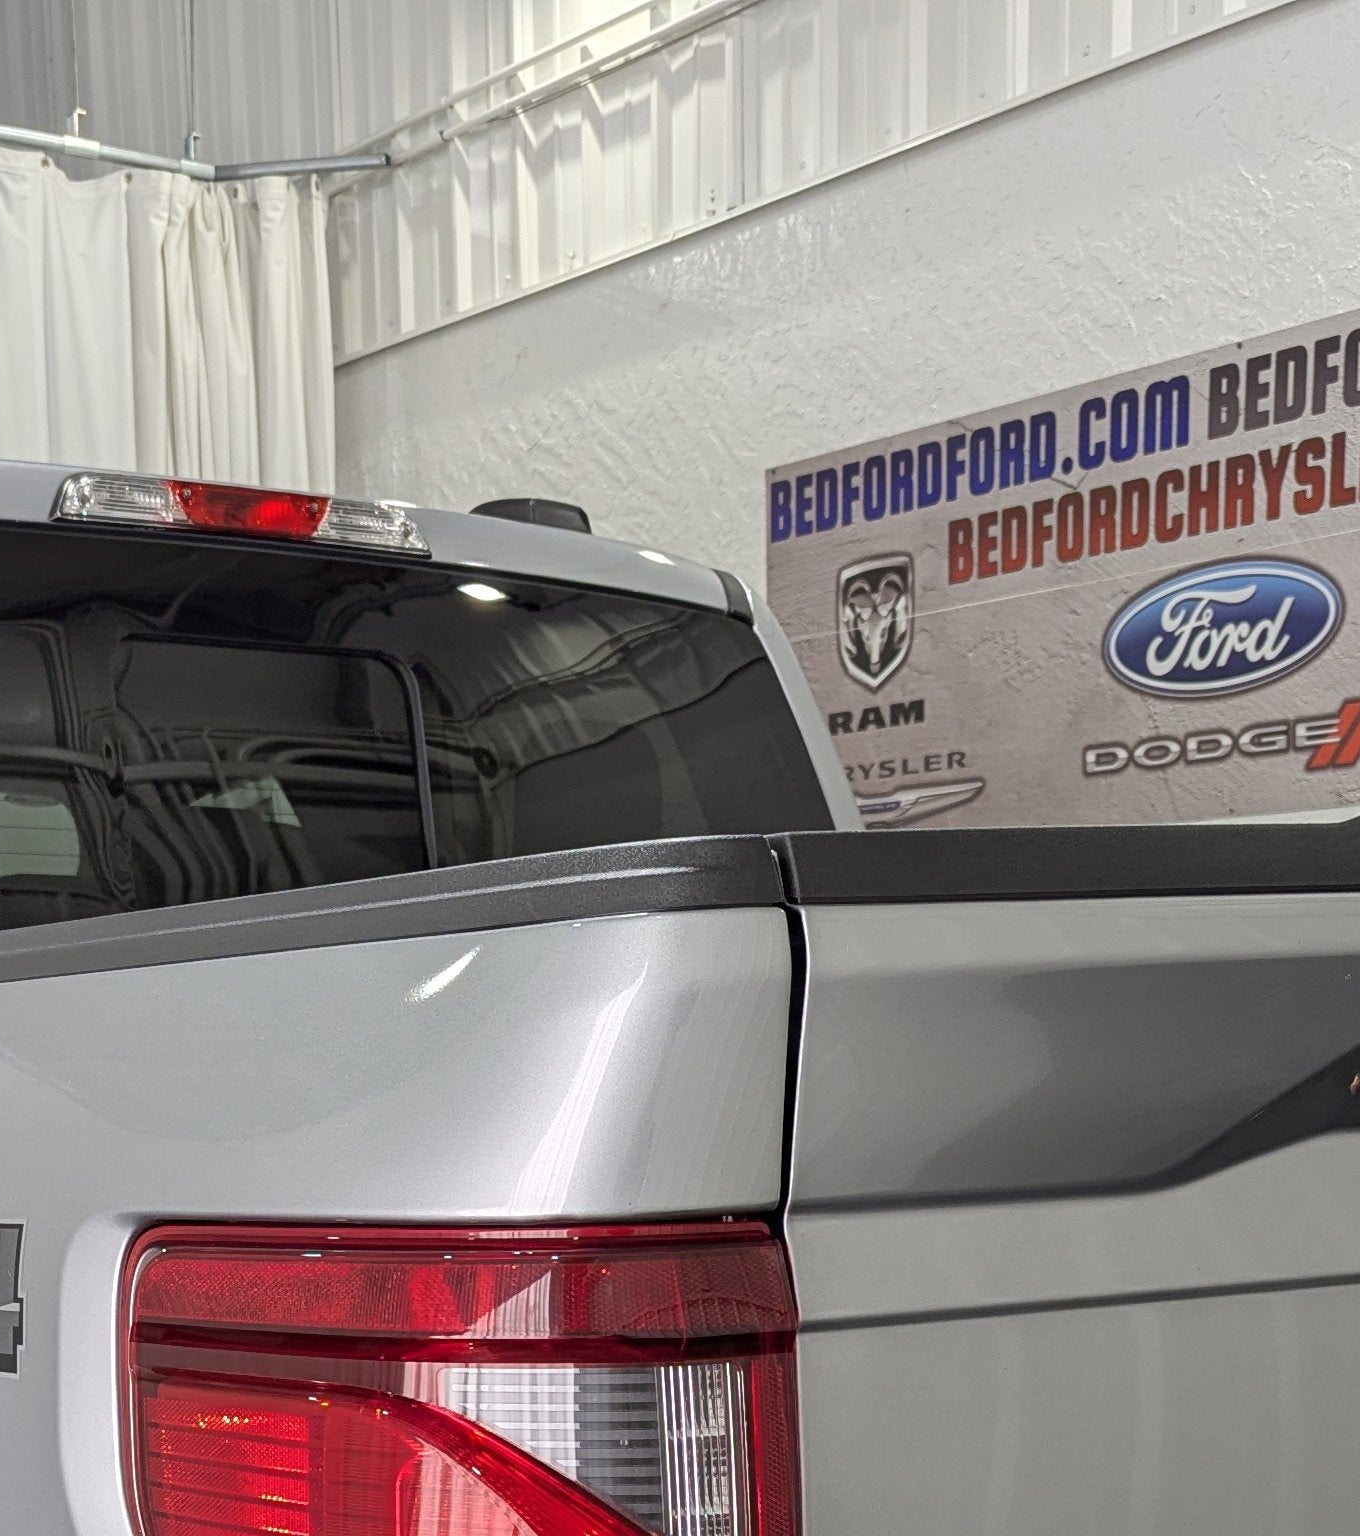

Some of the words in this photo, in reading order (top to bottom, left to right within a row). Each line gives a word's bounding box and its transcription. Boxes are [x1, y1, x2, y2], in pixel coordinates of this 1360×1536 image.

[771, 376, 1189, 542] BEDFORDFORD.COM
[1146, 580, 1297, 677] Ford
[828, 699, 926, 737] RAM
[1082, 717, 1344, 778] DODGE
[843, 751, 967, 783] RYSLER
